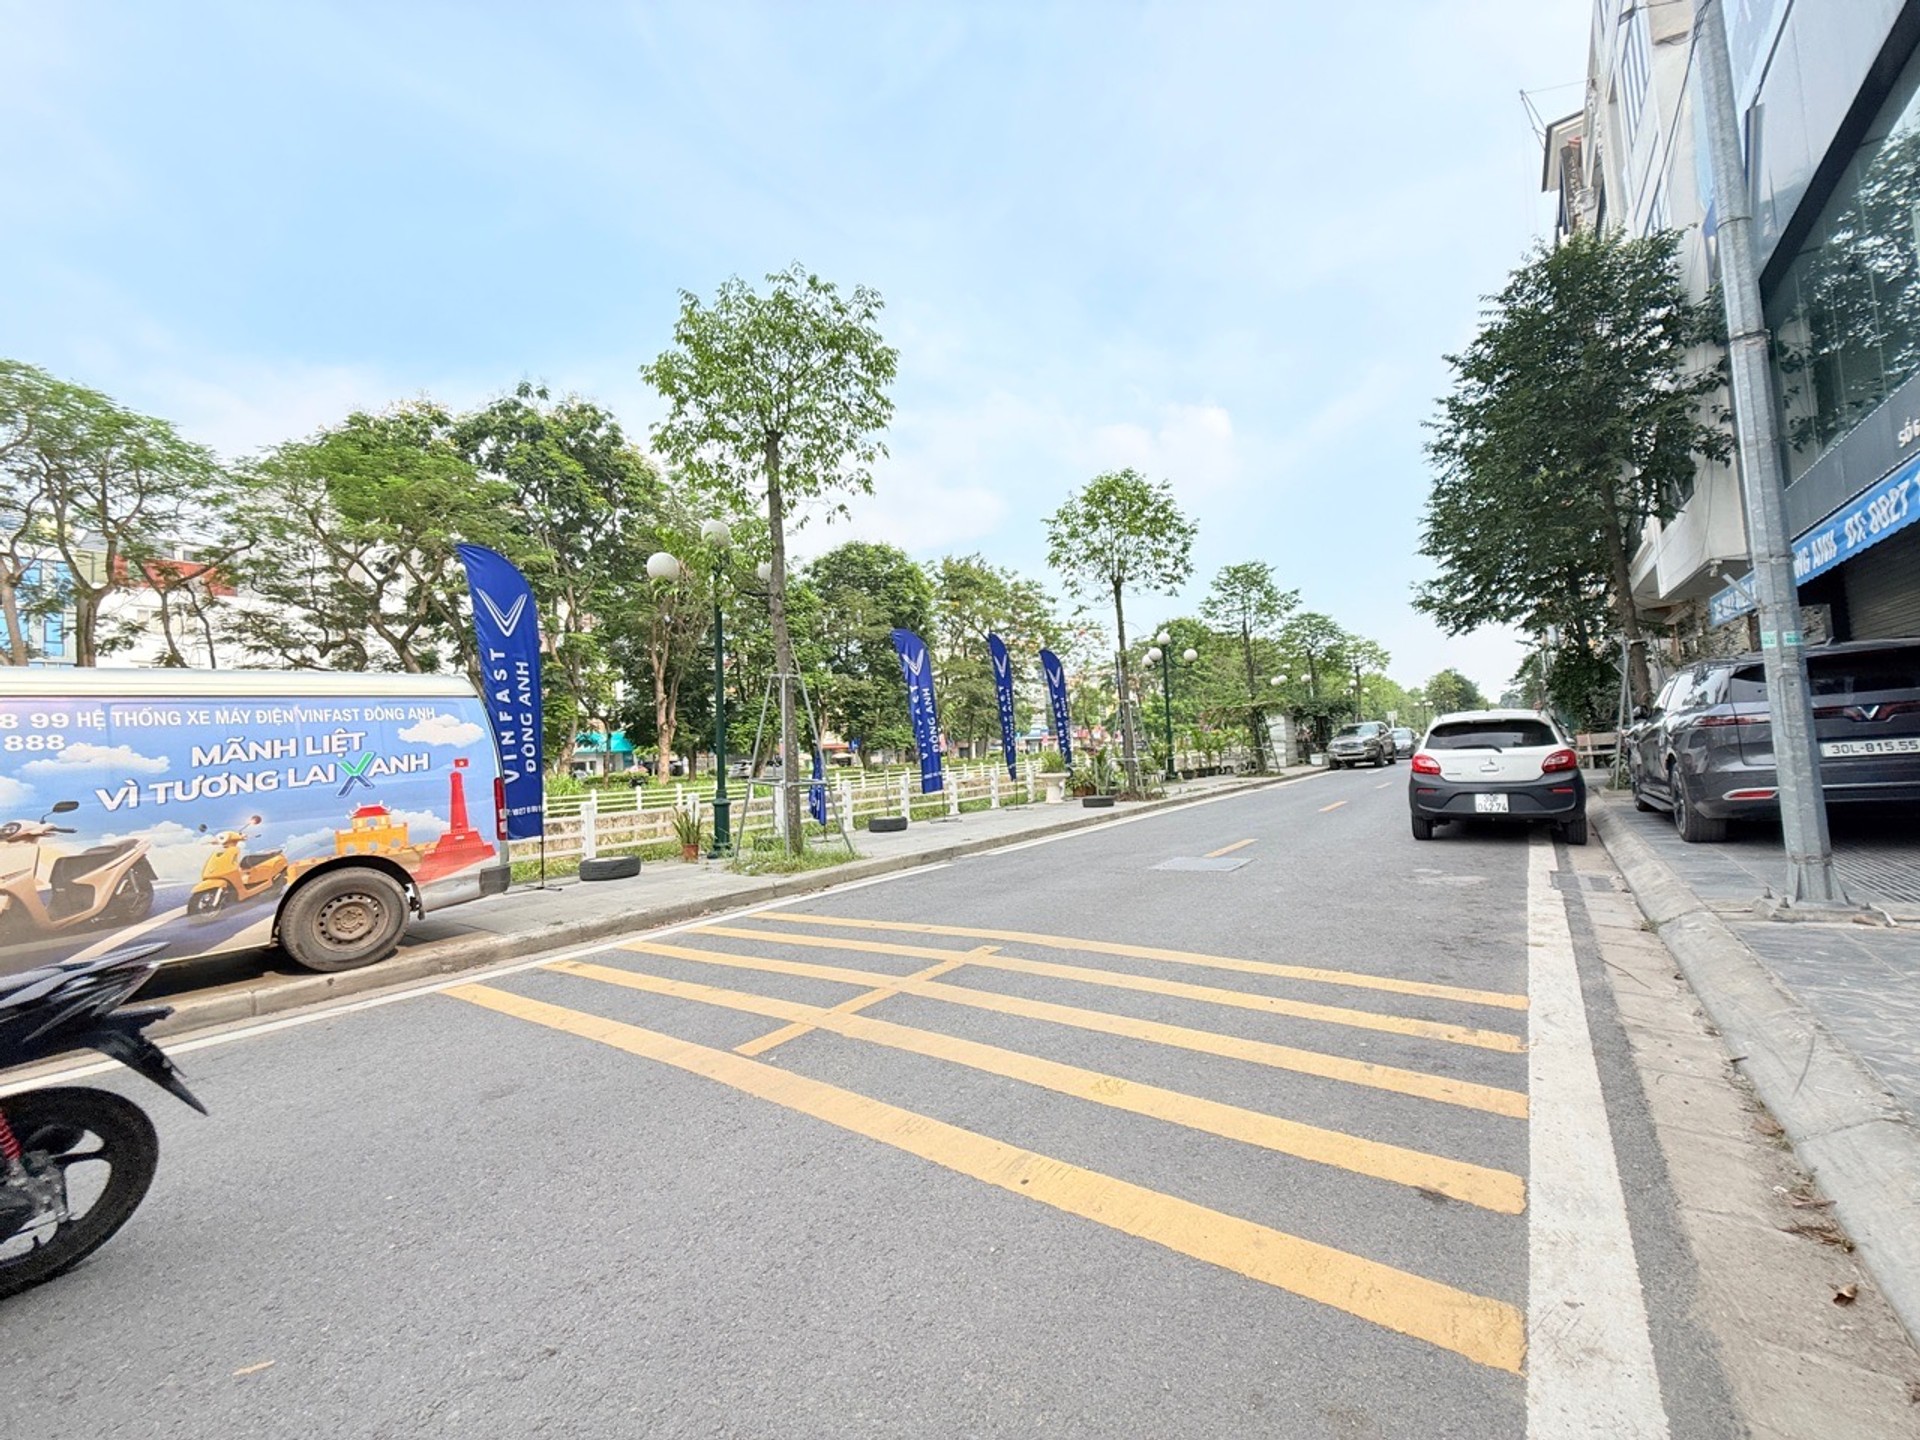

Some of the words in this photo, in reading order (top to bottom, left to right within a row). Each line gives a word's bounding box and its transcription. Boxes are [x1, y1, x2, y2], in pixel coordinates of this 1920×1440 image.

[1868, 479, 1910, 534] 0827
[515, 661, 532, 707] ANH
[922, 688, 934, 713] ANH
[30, 712, 69, 729] 99
[77, 709, 106, 731] HỆ
[111, 707, 181, 726] THỐNG
[187, 710, 211, 725] XE
[216, 706, 251, 725] MÁY
[256, 707, 294, 726] ĐIỆN
[298, 708, 360, 723] VINFAST
[408, 706, 435, 721] ANH
[490, 648, 520, 784] VINFAST
[4, 734, 65, 751] 888
[191, 736, 298, 768] MÃNH
[305, 728, 367, 758] LIỆT
[520, 713, 537, 772] ĐÔNG
[1830, 741, 1919, 755] 30L-815.55
[95, 778, 139, 811] VÌ
[149, 771, 280, 804] TƯƠNG
[287, 763, 337, 788] LAI
